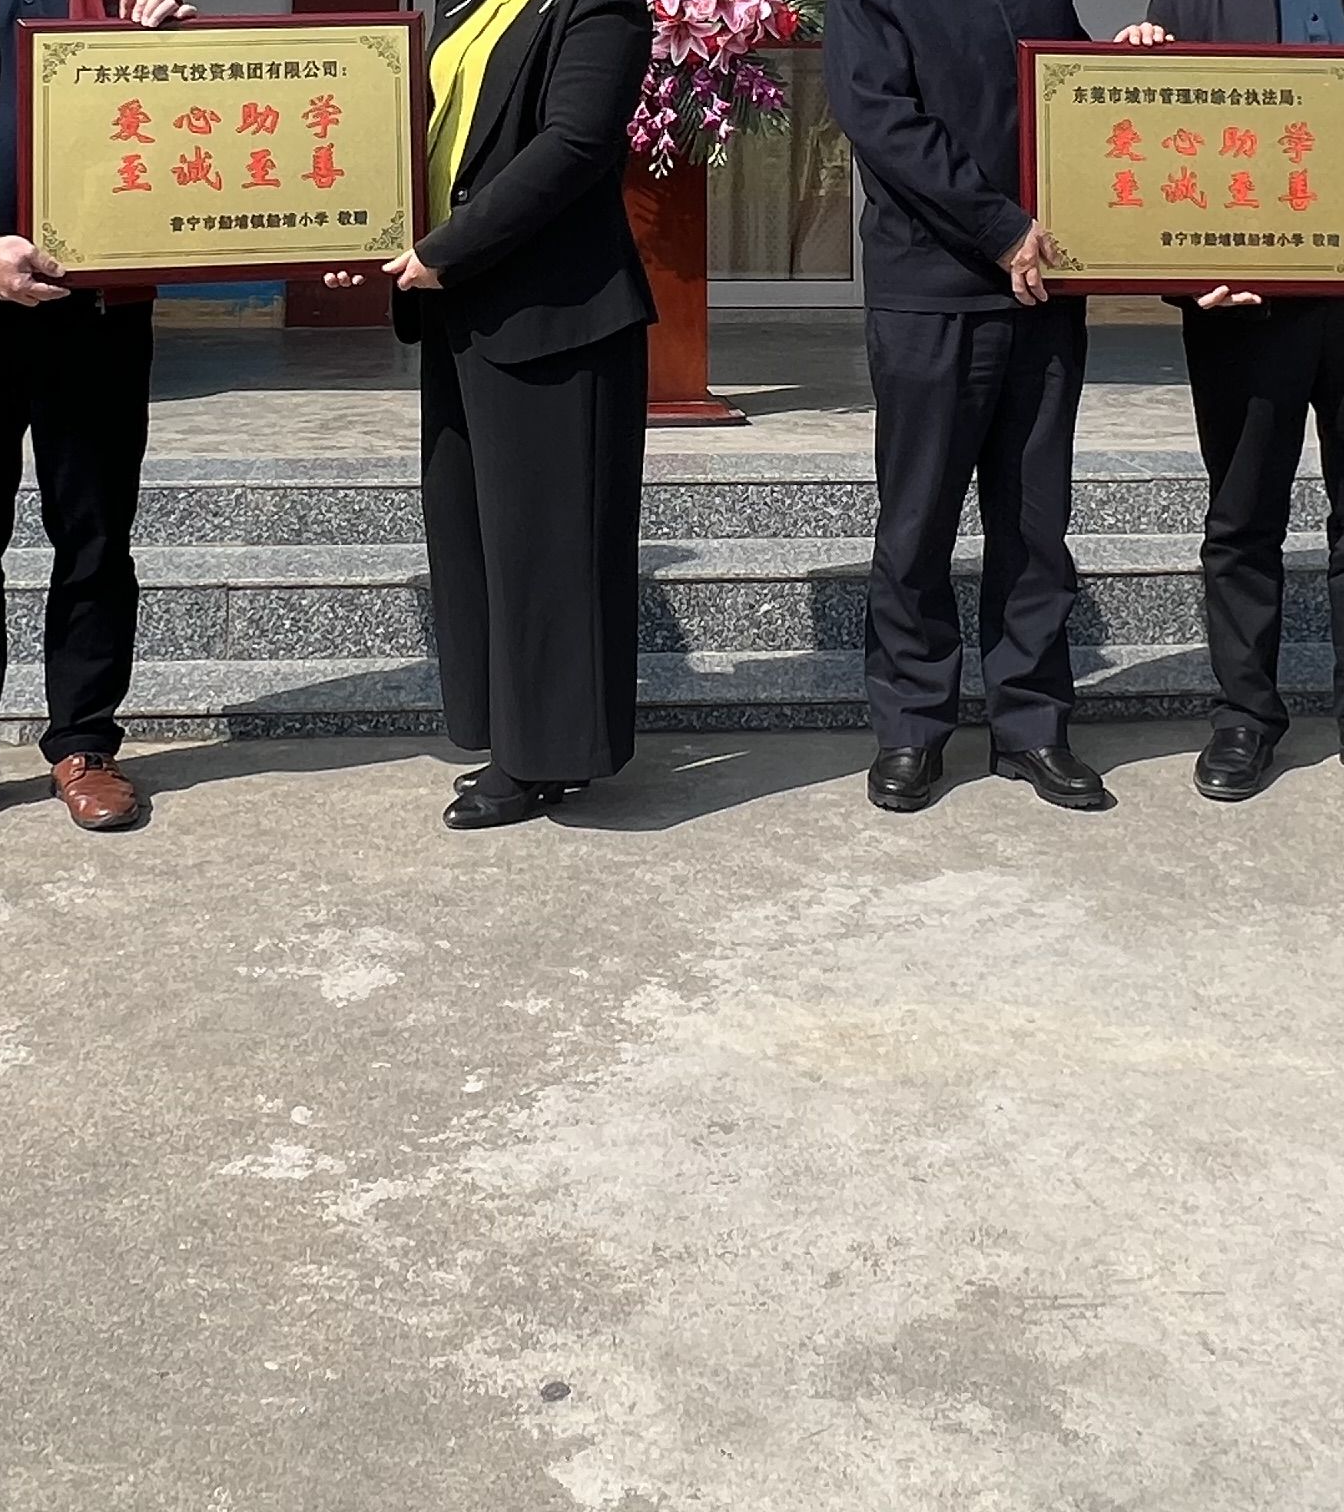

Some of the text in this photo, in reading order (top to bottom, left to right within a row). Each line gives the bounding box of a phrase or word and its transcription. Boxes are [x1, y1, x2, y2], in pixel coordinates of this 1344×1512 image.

[109, 94, 343, 144] 爱心助学
[1105, 118, 1316, 163] 爱心助学
[110, 142, 346, 195] 至诚至善
[1107, 166, 1317, 211] 至诚至善
